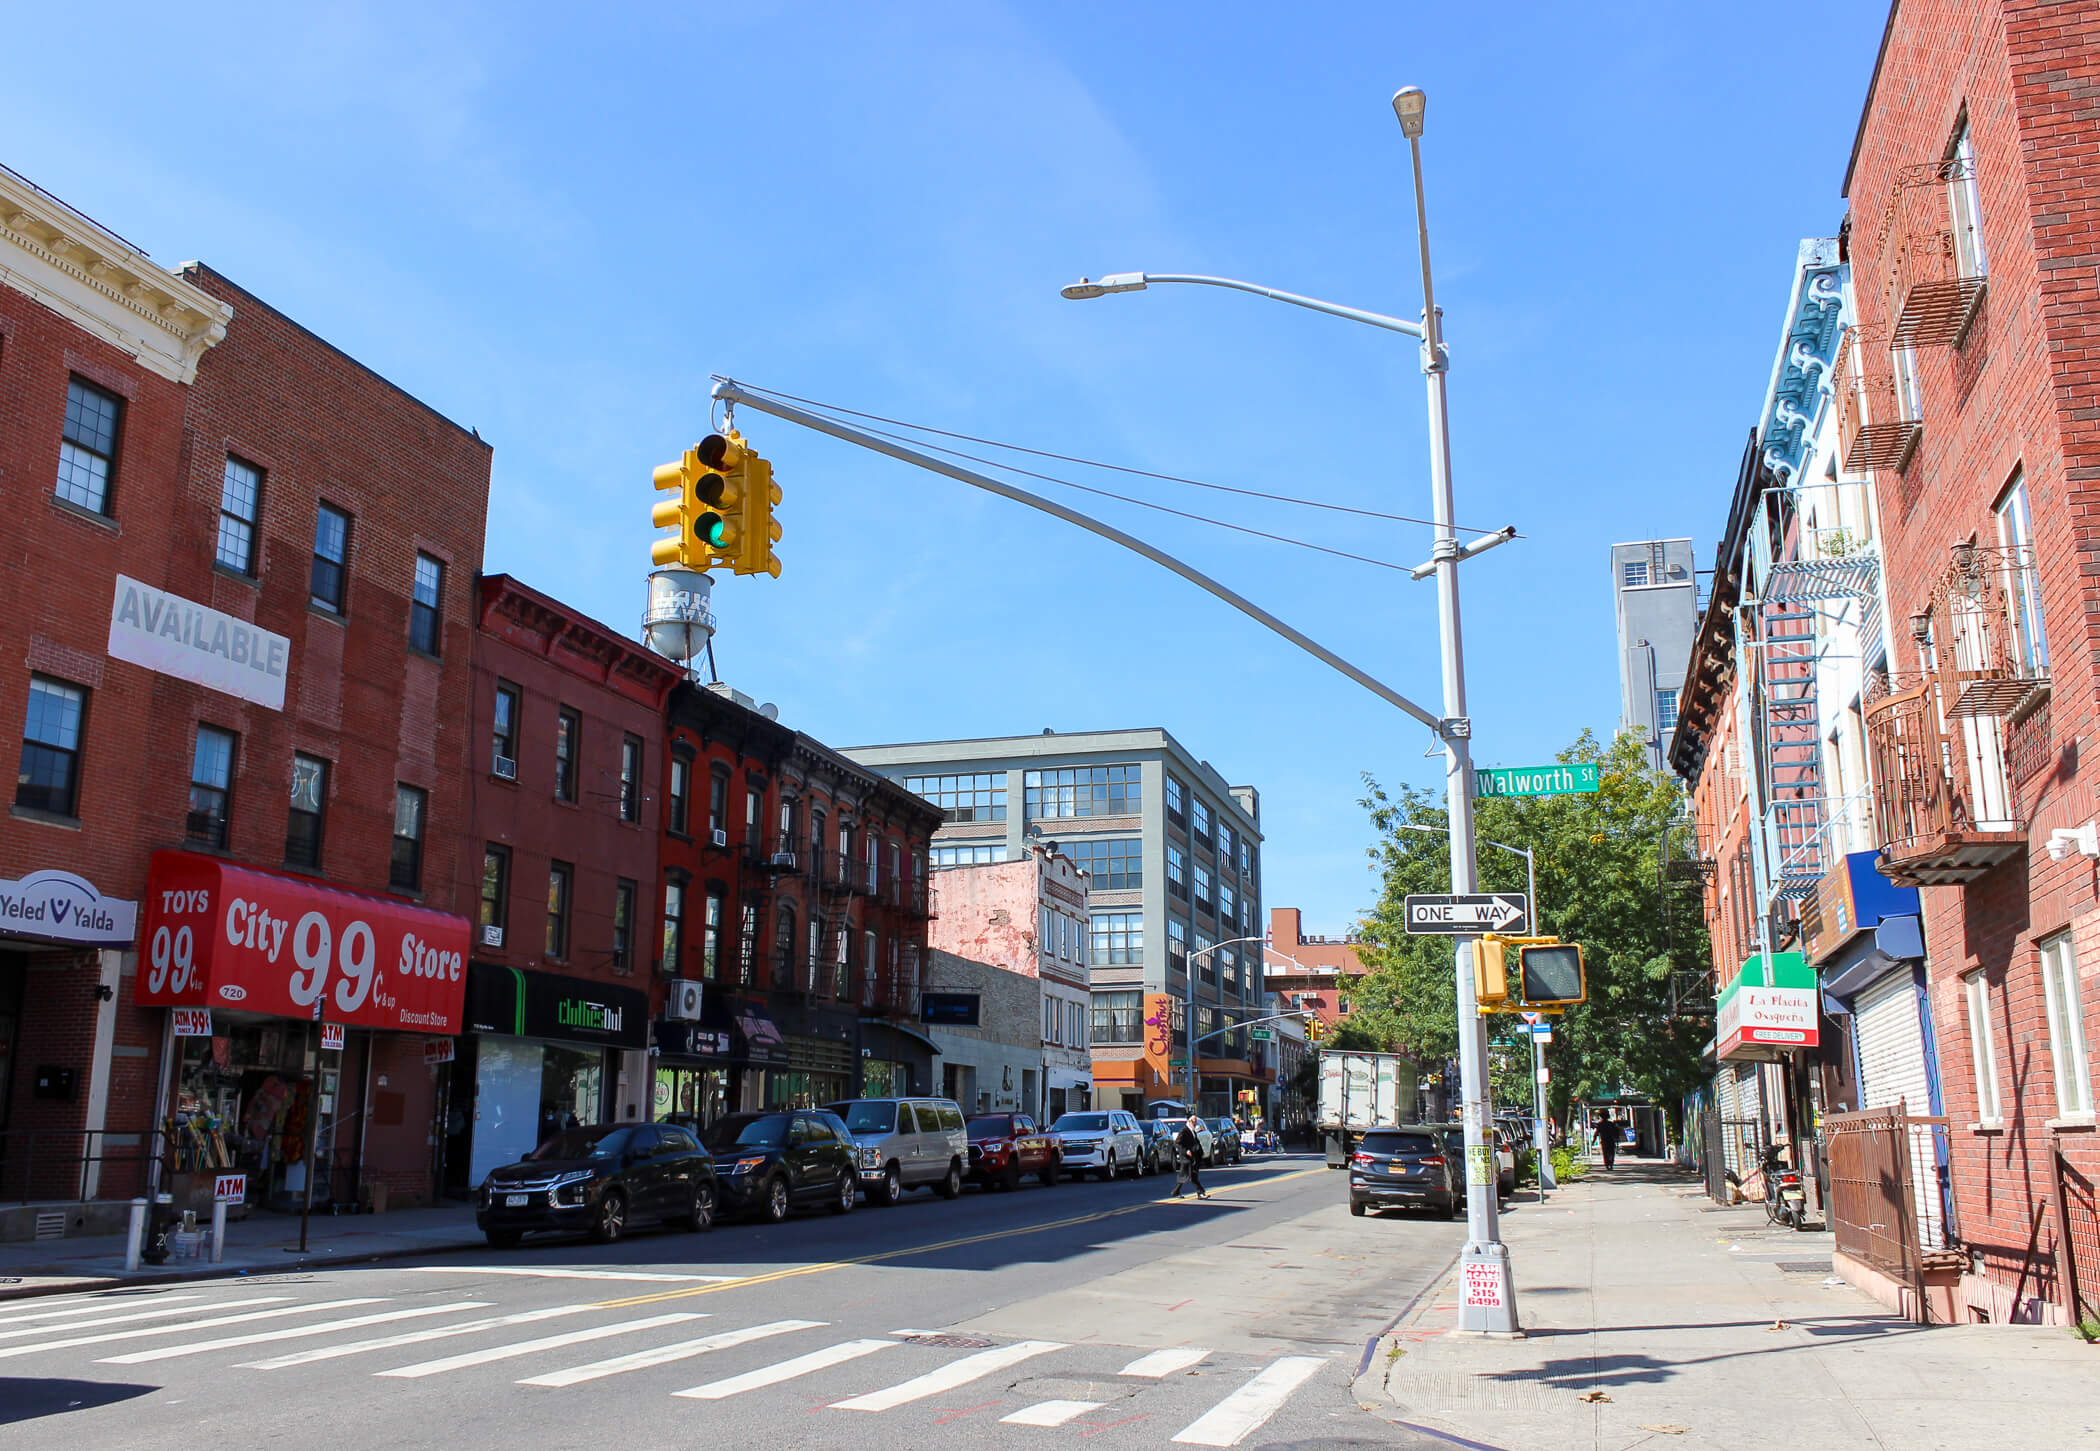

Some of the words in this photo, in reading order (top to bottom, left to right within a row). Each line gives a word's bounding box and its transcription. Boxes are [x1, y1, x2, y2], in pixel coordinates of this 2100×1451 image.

[117, 586, 284, 676] AVAILABLE
[1479, 767, 1574, 794] Walworth
[1581, 768, 1594, 782] St
[162, 890, 209, 914] TOYS
[0, 894, 46, 921] Yeled
[74, 906, 114, 931] Yalda
[1416, 907, 1453, 921] ONE
[1475, 906, 1512, 921] WAY
[226, 897, 288, 963] City
[399, 932, 461, 982] Store
[223, 986, 244, 998] 720
[175, 1011, 191, 1026] ATM
[399, 1008, 429, 1025] Discount
[430, 1010, 448, 1027] Store
[321, 1024, 343, 1041] ATM
[1755, 1031, 1772, 1040] FREE
[1774, 1031, 1803, 1041] DELIVERY
[217, 1178, 243, 1195] ATM
[1468, 1297, 1500, 1306] 6499
[1473, 1289, 1496, 1297] 515
